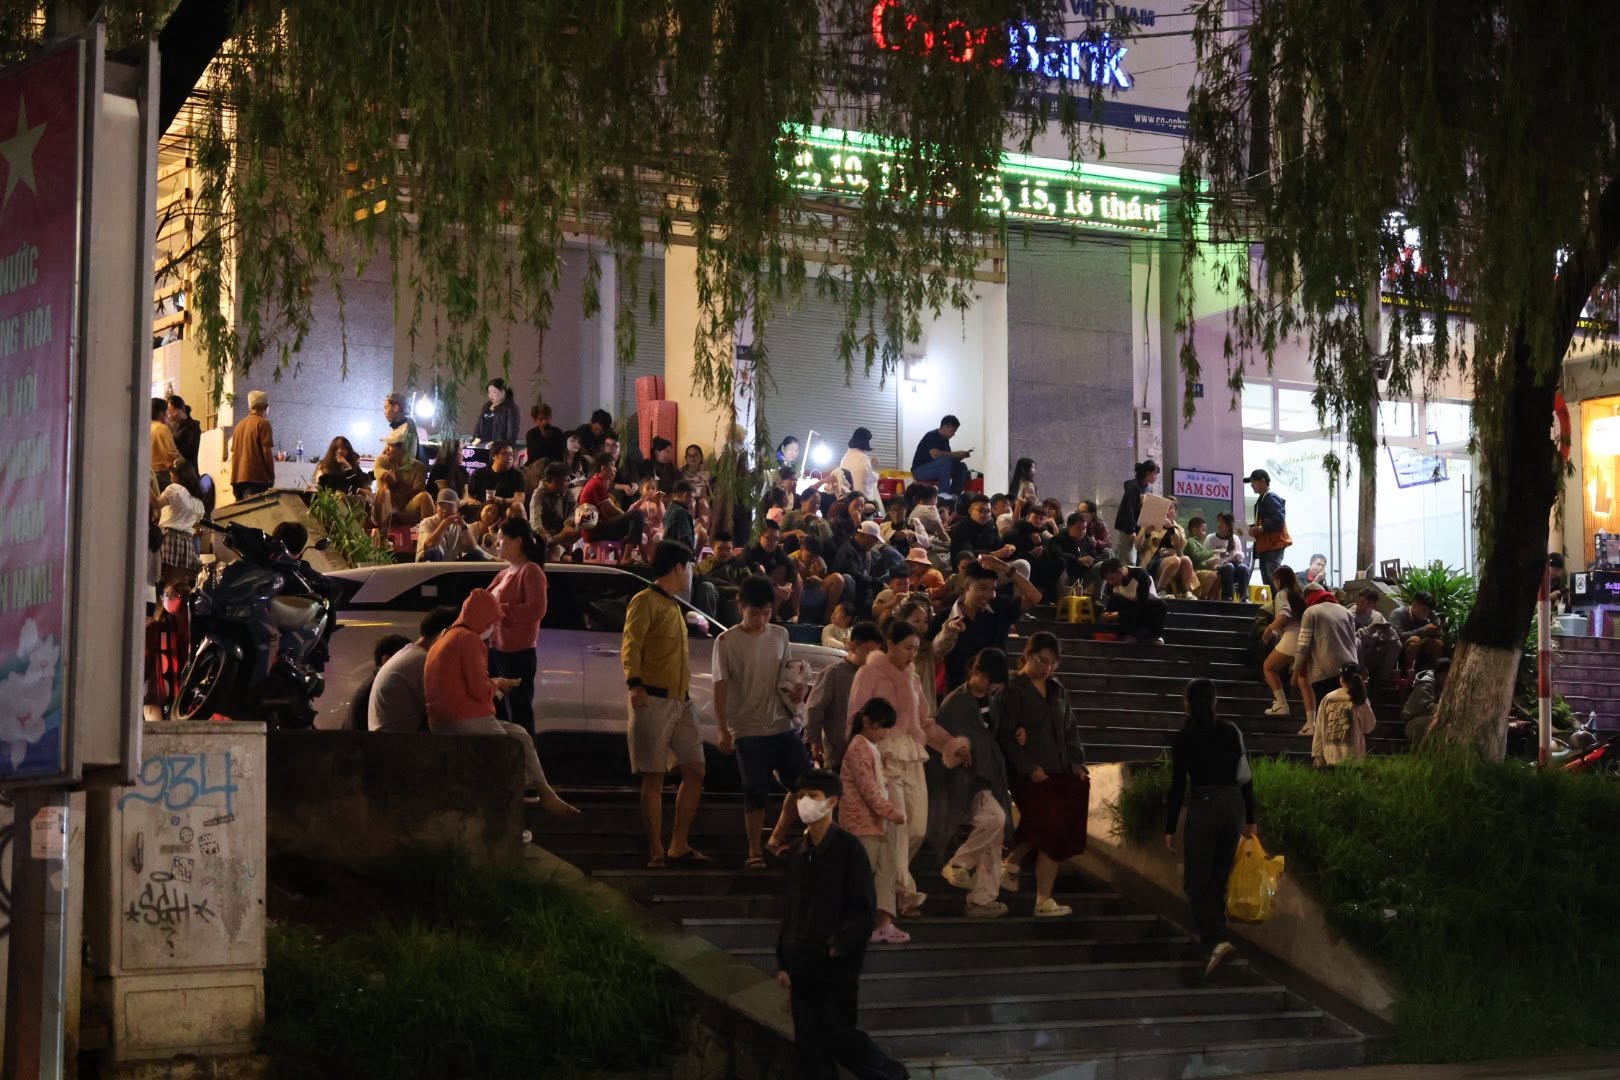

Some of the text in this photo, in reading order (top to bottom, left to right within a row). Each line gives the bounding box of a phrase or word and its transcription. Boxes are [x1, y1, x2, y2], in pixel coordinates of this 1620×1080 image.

[1114, 4, 1155, 27] NAM
[1177, 481, 1229, 498] NAM SƠN
